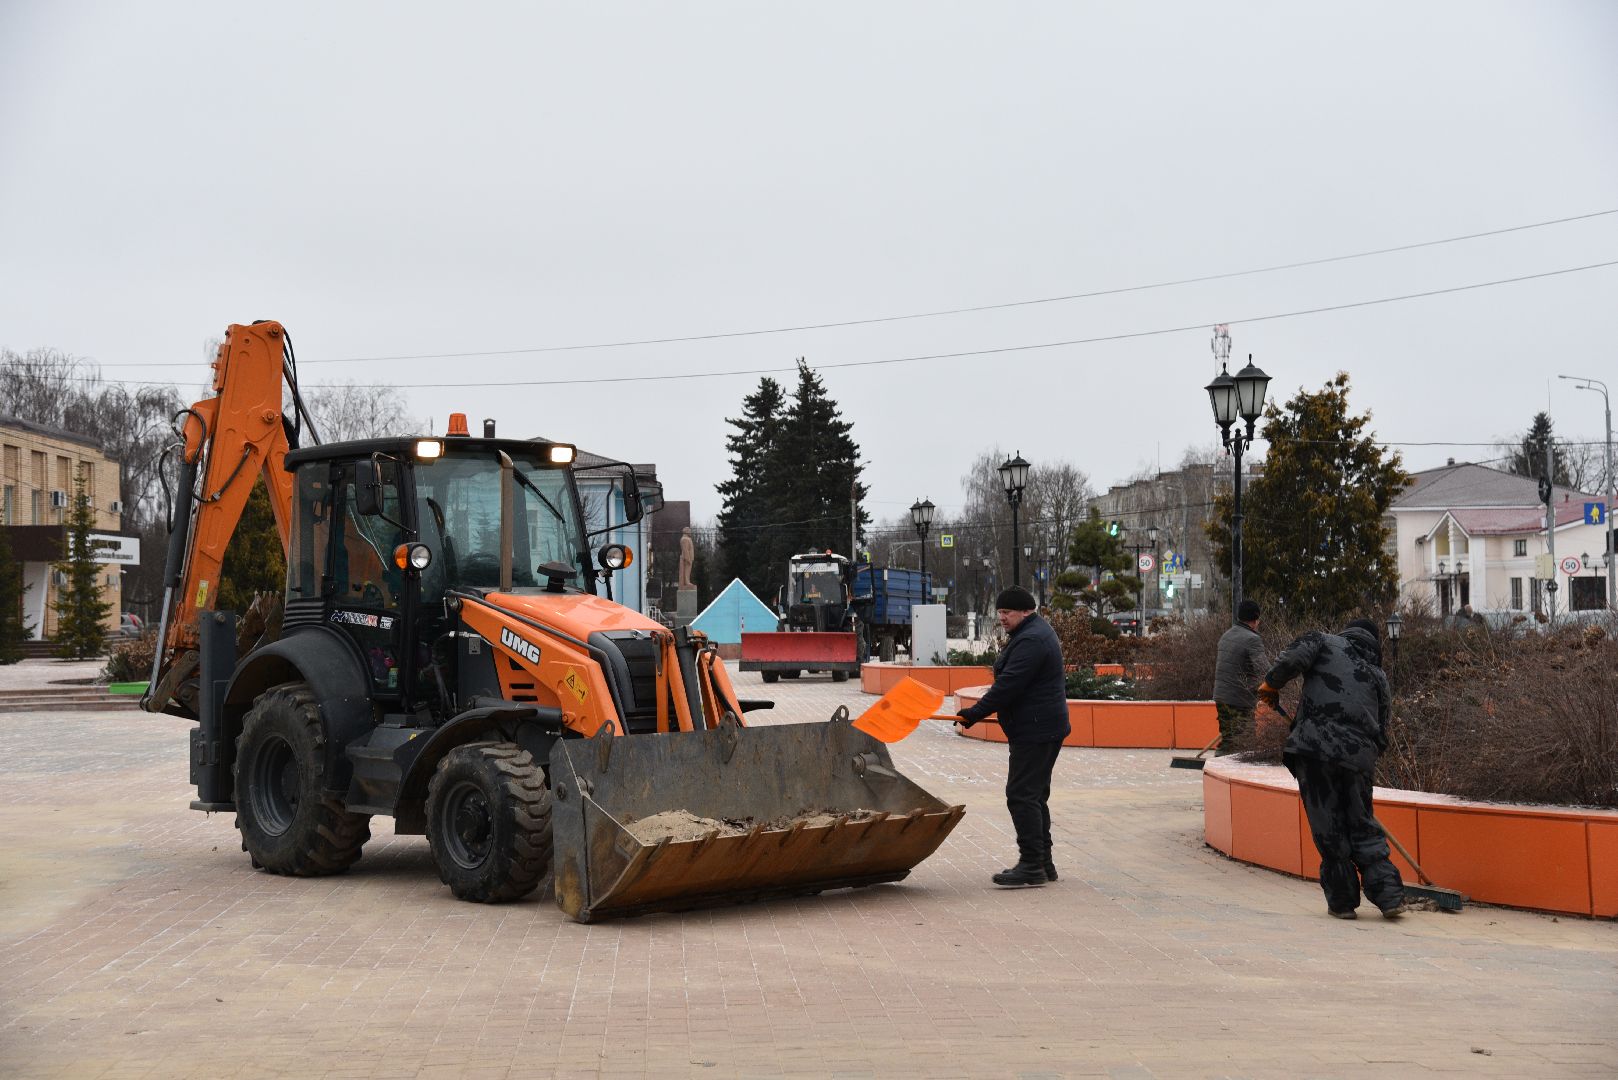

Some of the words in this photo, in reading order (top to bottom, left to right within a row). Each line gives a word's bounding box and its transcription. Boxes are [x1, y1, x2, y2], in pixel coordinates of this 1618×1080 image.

[1140, 559, 1151, 567] 50
[1565, 561, 1576, 570] 50
[501, 627, 540, 664] UMG
